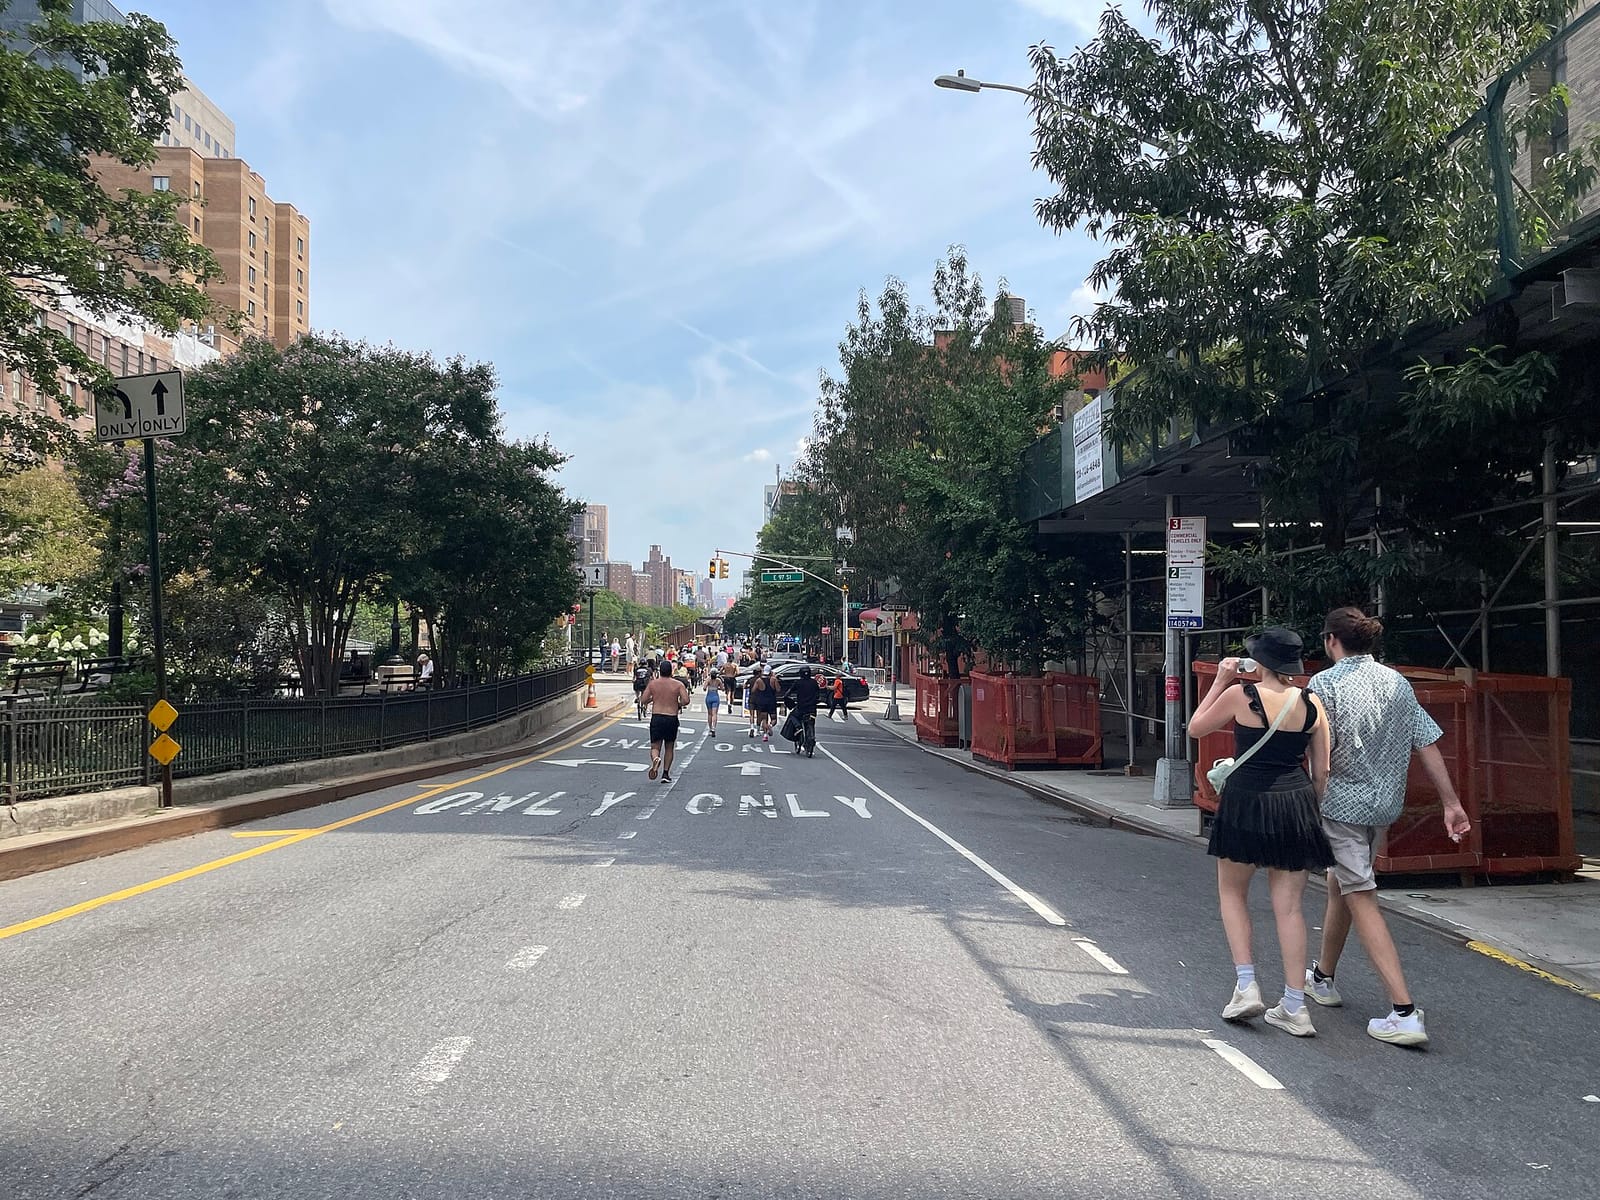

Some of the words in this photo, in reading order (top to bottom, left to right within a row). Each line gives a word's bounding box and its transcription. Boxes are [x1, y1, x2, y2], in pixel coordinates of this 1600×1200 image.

[100, 422, 137, 436] ONLY
[143, 417, 180, 432] ONLY
[1172, 519, 1179, 529] 3
[1171, 568, 1177, 578] 2
[413, 792, 637, 816] ONLY
[685, 793, 872, 819] ONLY
